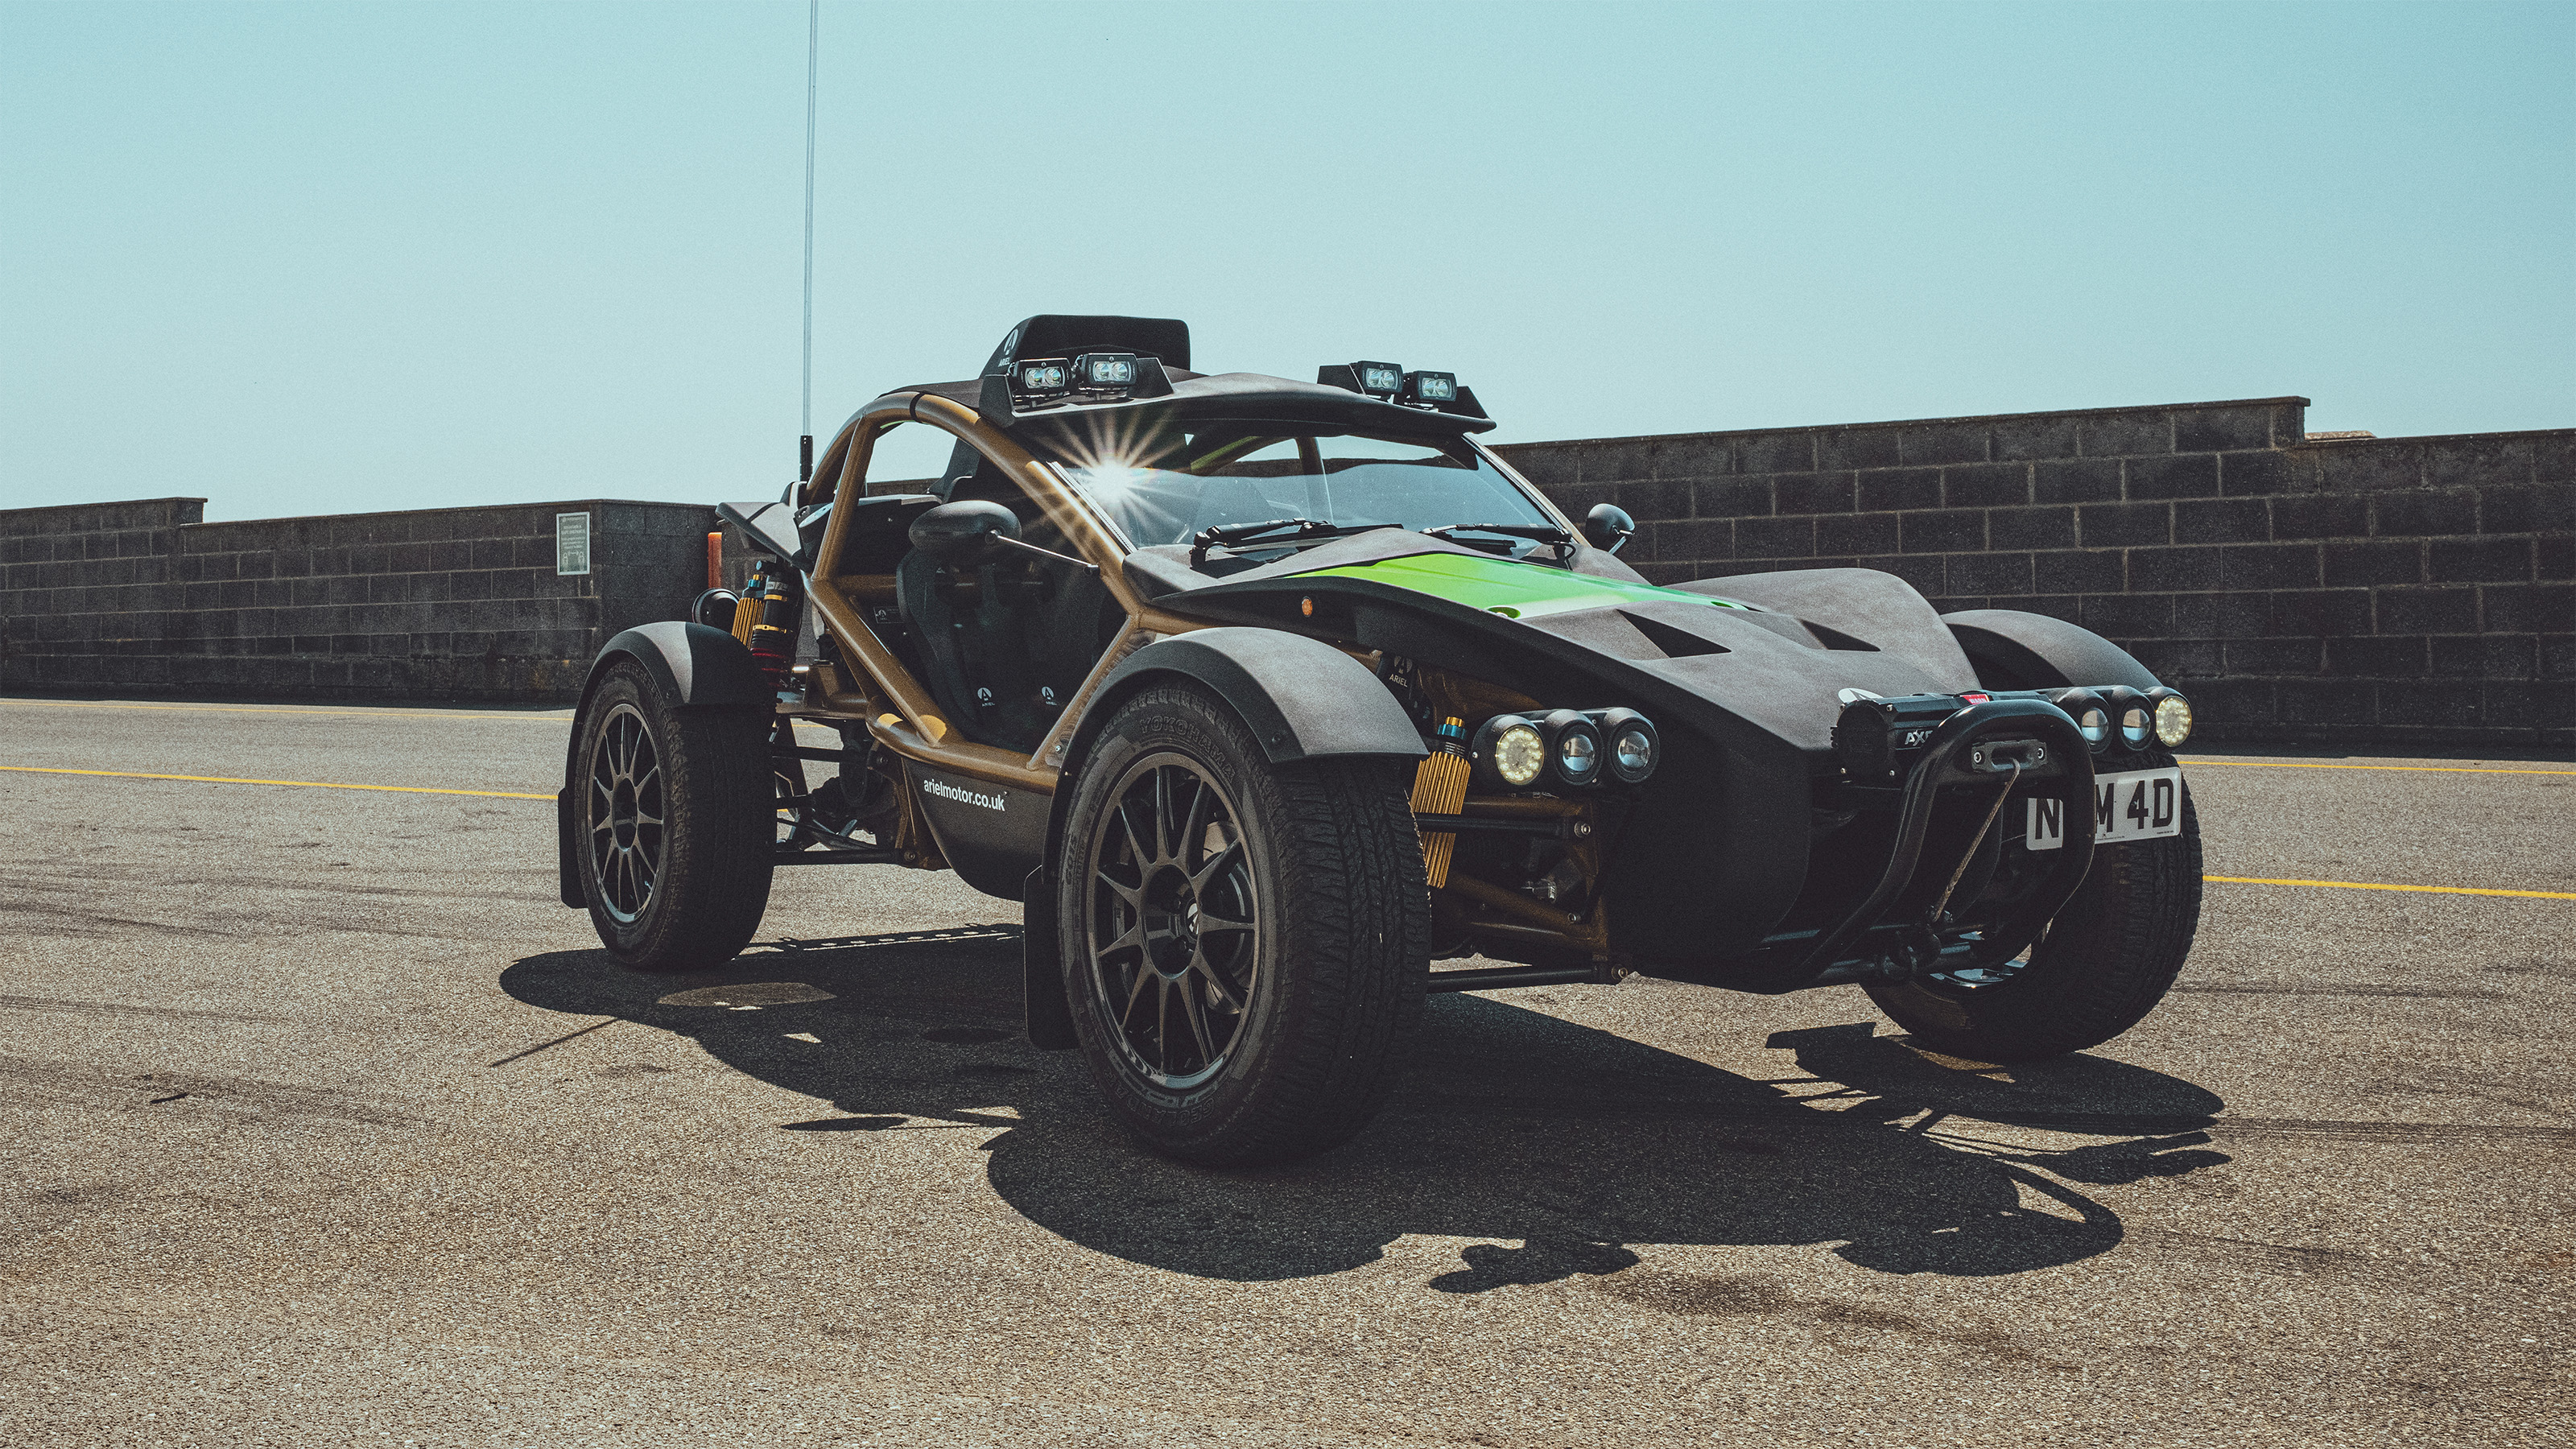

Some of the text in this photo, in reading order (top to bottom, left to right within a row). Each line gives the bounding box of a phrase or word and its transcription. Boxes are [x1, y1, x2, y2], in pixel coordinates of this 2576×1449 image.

[1389, 674, 1408, 687] ARIEL
[1139, 715, 1236, 783] YOKOHAMA
[923, 778, 1005, 811] arielmotor.co.uk
[2127, 778, 2174, 830] 4D
[1102, 1067, 1216, 1127] GEOLANDAR
